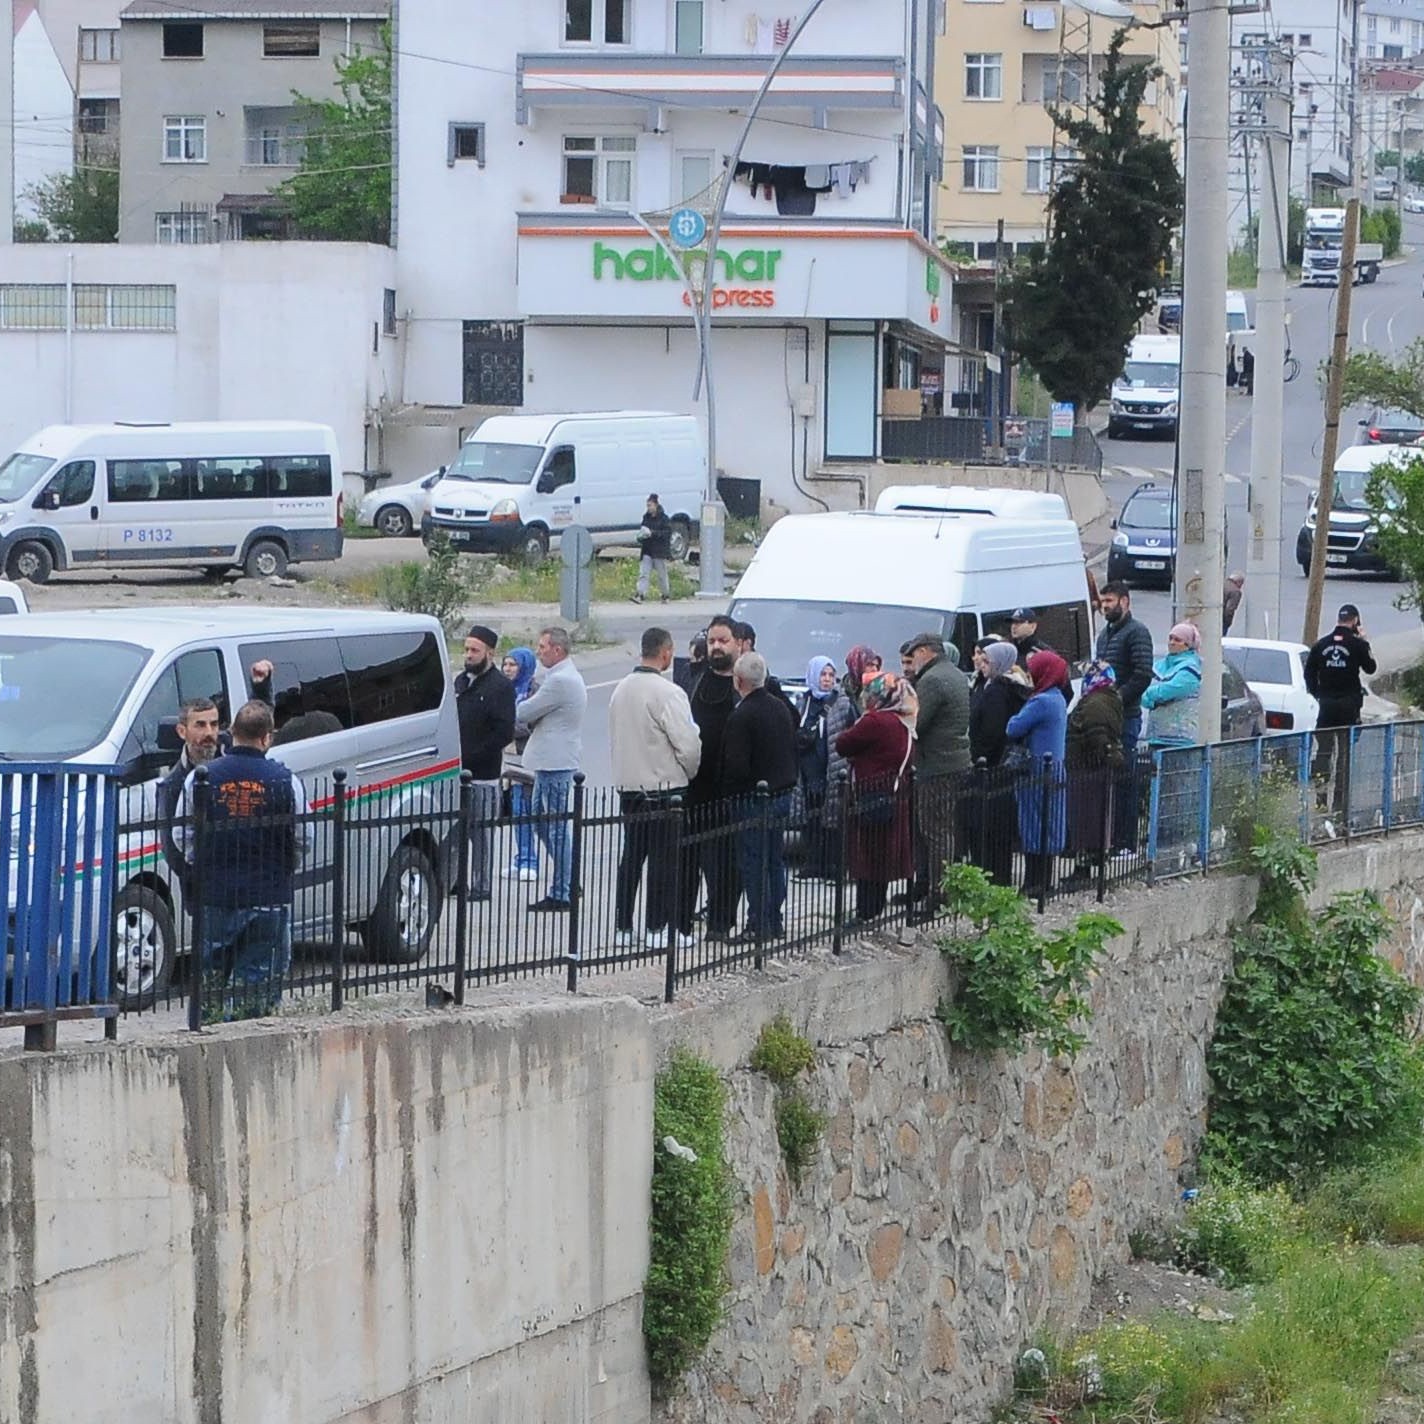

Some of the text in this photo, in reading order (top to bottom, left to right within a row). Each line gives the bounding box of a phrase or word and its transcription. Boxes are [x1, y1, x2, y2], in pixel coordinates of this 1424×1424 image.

[593, 241, 782, 281] hakmar
[683, 289, 774, 310] epress
[124, 528, 173, 543] P 8132
